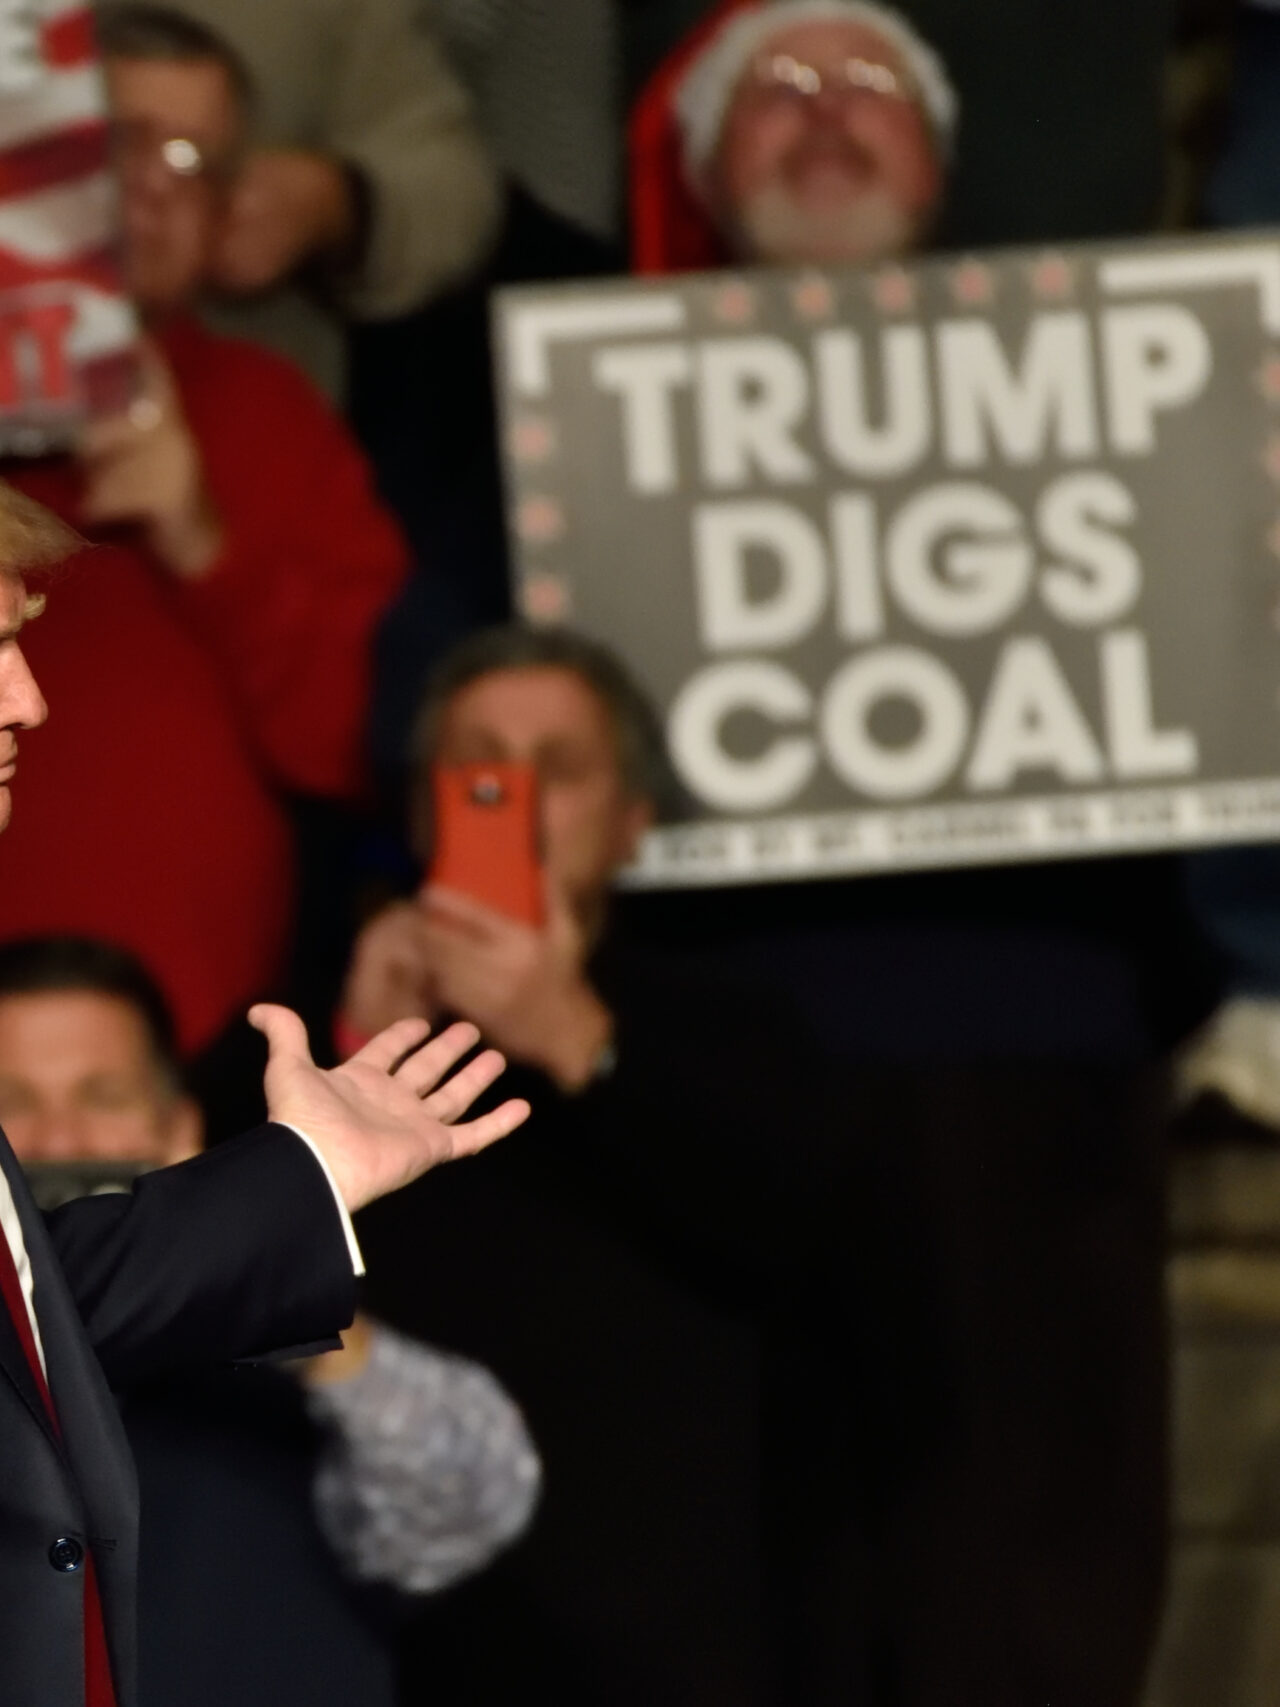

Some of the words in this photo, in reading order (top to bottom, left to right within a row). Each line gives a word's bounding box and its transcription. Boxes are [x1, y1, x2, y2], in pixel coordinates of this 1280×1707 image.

[595, 304, 1211, 493] TRUMP
[693, 471, 1141, 651] DIGS
[669, 629, 1198, 811] COAL
